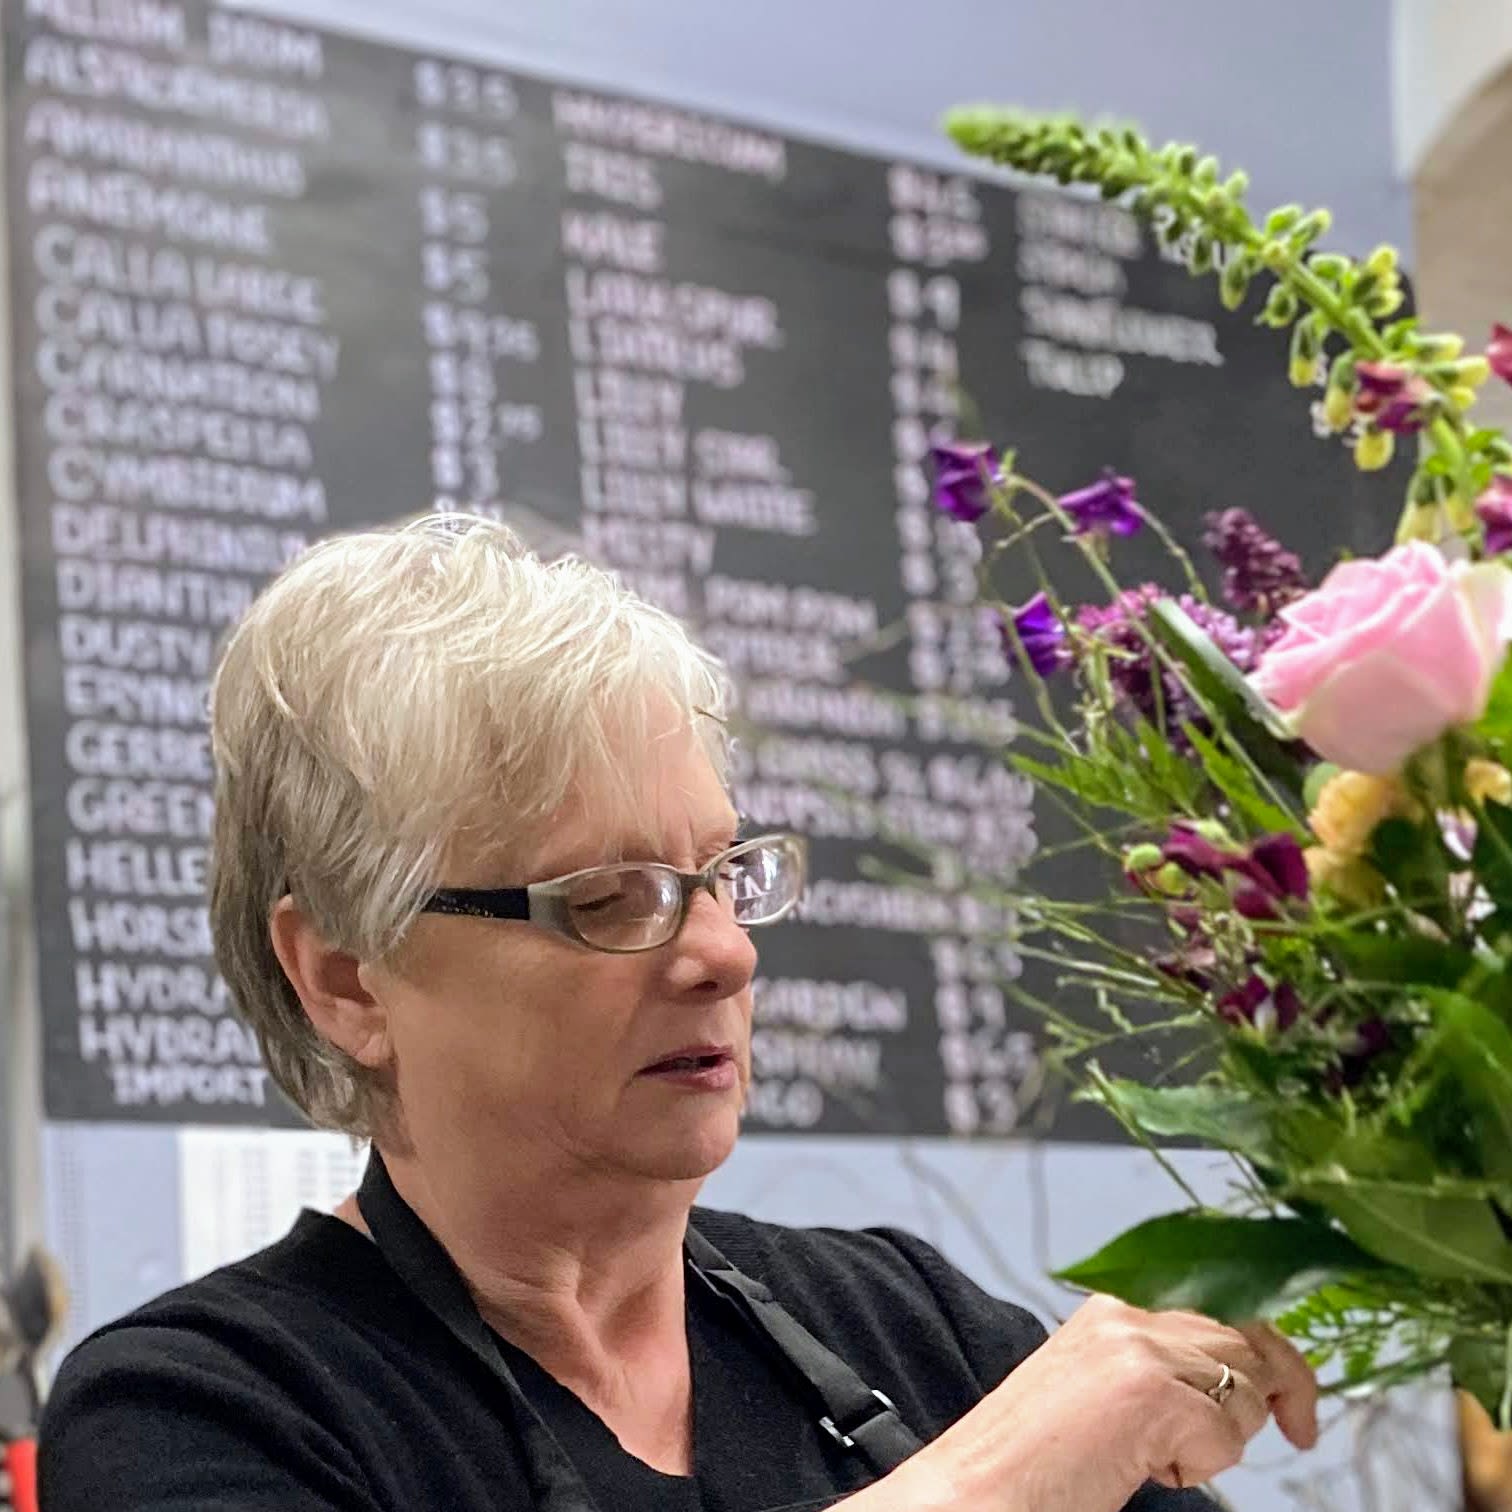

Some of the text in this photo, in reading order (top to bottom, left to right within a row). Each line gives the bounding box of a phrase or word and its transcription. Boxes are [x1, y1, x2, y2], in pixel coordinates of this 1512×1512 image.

[33, 223, 194, 296] CALLA
[58, 613, 212, 674] DUSTY
[65, 838, 209, 897] HELLE
[112, 1066, 267, 1109] IMPORT
